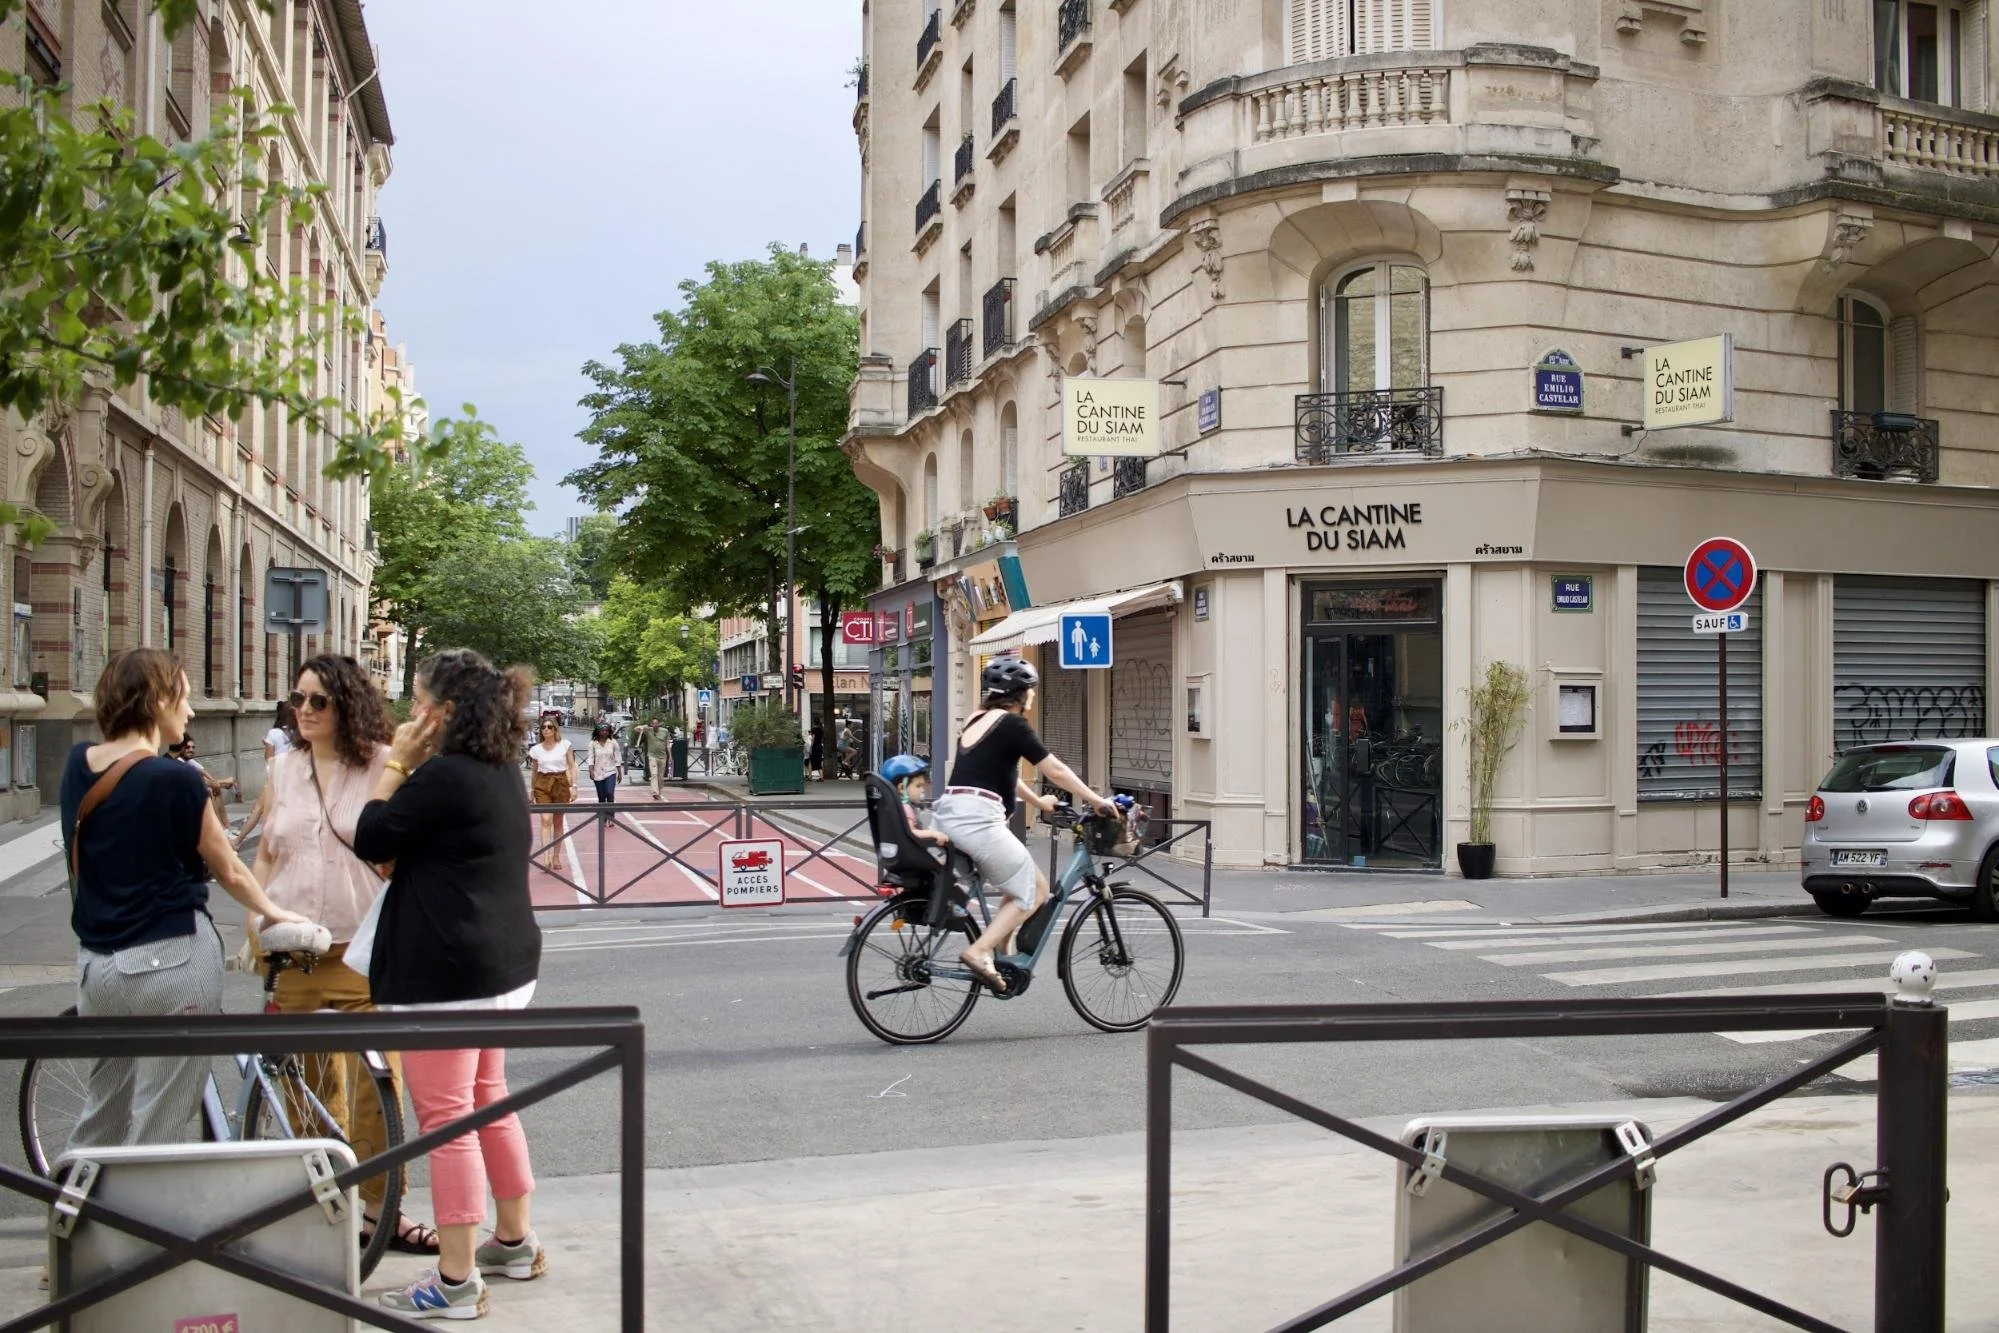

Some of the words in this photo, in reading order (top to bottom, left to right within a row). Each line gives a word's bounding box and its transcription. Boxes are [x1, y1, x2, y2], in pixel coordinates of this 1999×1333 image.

[1655, 357, 1670, 372] LA
[1551, 374, 1567, 383] RUE
[1656, 366, 1712, 388] CANTINE
[1544, 383, 1574, 394] EMILIO
[1655, 389, 1674, 405] DU
[1678, 385, 1711, 402] SIAM
[1076, 390, 1094, 403] LA
[1539, 393, 1579, 404] CASTELAR
[1077, 404, 1145, 419] CANTINE
[1655, 403, 1691, 414] RESTAURANT
[1077, 420, 1099, 434] DU
[1105, 420, 1144, 434] SIAM
[1286, 506, 1315, 528] LA
[1320, 503, 1422, 526] CANTINE
[1306, 530, 1340, 551] DU
[1346, 527, 1406, 550] SIAM
[1565, 583, 1580, 591] RUE
[1695, 618, 1726, 630] SAUF
[727, 884, 779, 895] POMPIERS
